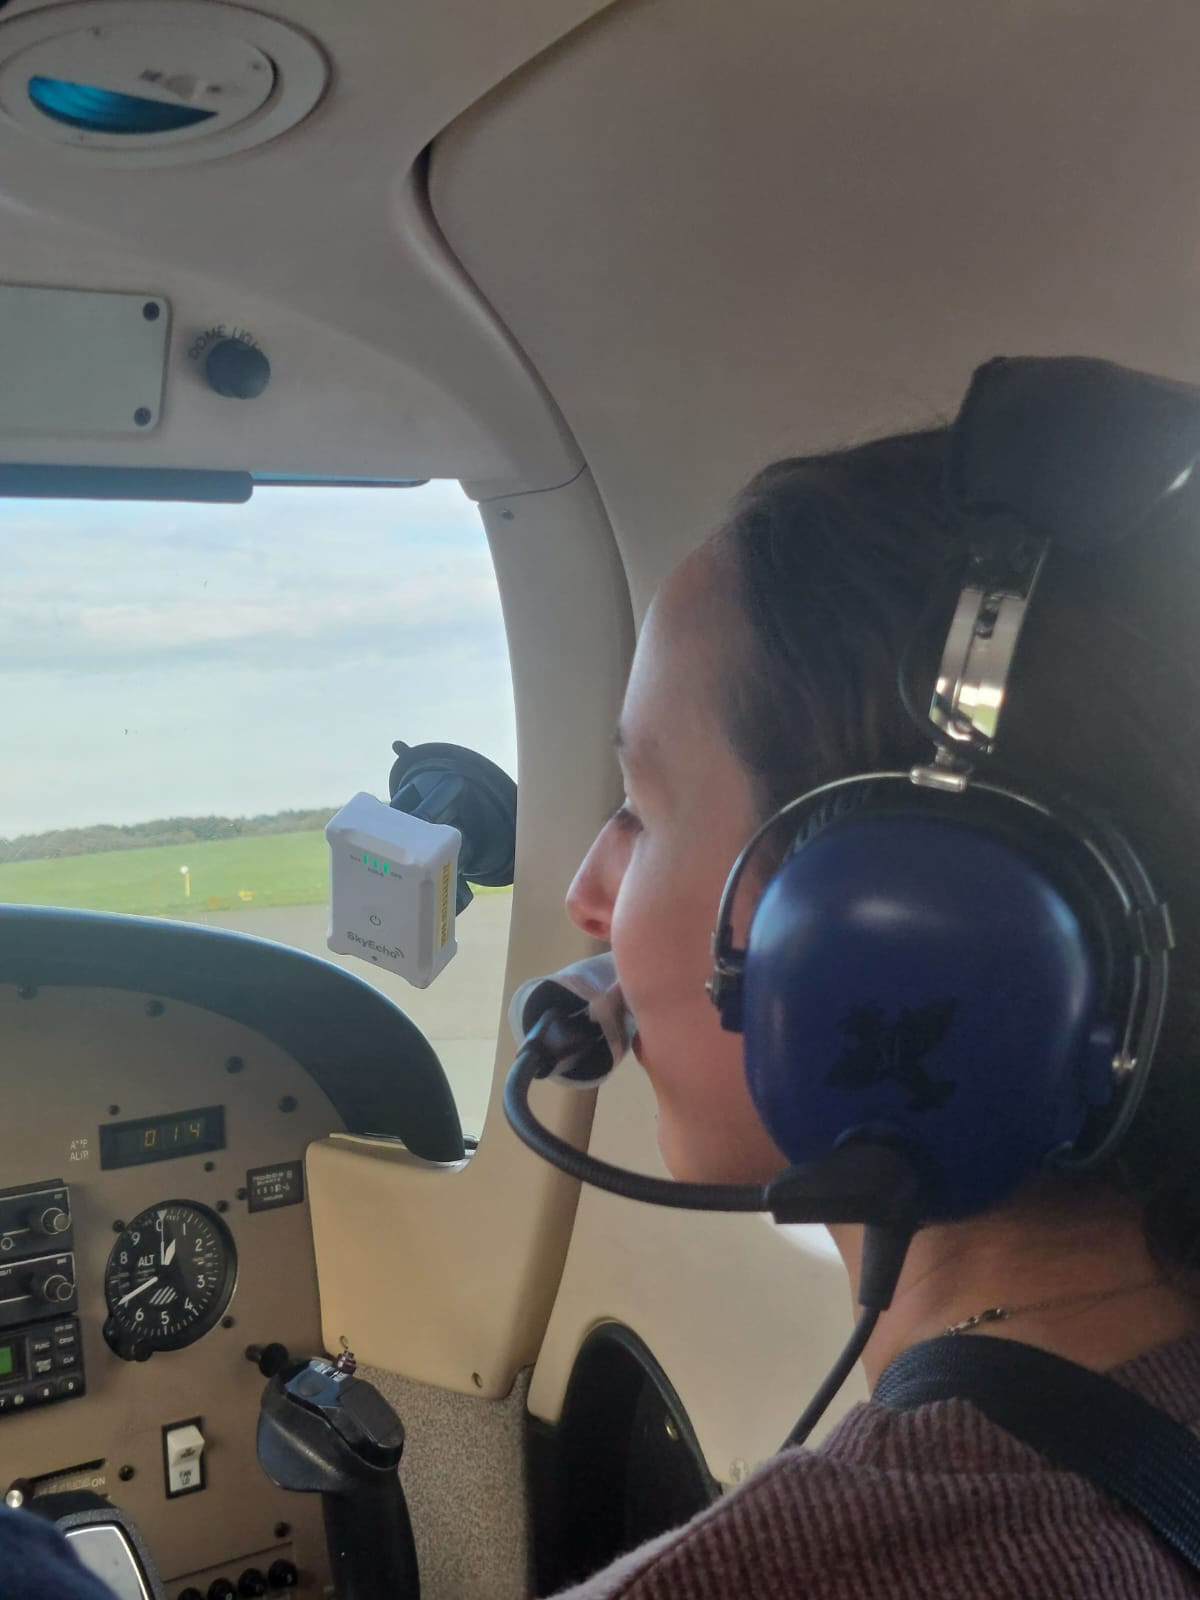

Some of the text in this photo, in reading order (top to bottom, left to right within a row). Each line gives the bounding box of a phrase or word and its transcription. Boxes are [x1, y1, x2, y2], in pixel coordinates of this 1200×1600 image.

[346, 930, 398, 959] SkyEcho
[131, 1232, 141, 1246] 9
[195, 1239, 203, 1252] 2
[120, 1252, 128, 1265] 8
[137, 1254, 155, 1267] ALT
[196, 1275, 205, 1288] 3
[184, 1297, 193, 1309] 4
[135, 1308, 145, 1321] 6
[160, 1311, 170, 1325] 5
[91, 1477, 106, 1488] ON
